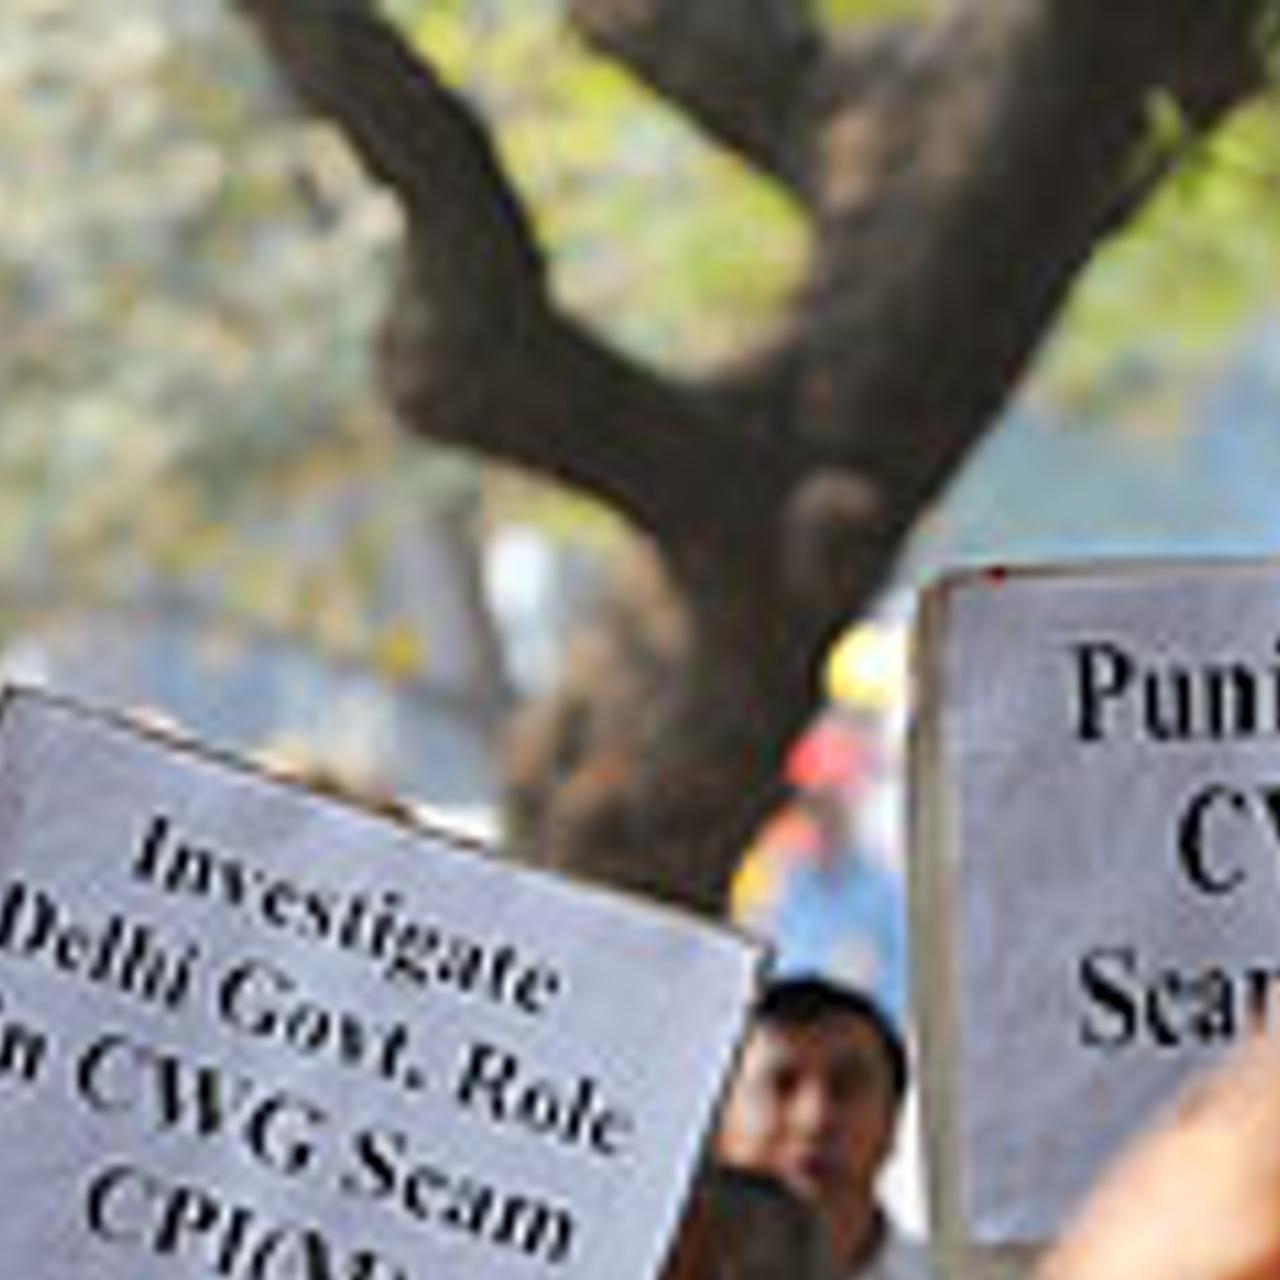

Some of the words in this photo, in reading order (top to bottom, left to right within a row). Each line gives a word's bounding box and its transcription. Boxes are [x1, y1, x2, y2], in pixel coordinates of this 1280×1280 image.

[0, 881, 199, 1010] Delhi
[219, 961, 424, 1090] Govt.
[457, 1043, 634, 1157] Role
[134, 815, 560, 1014] Investigate
[0, 1020, 46, 1082] n
[77, 1034, 324, 1175] CWG
[342, 1131, 576, 1263] Scam
